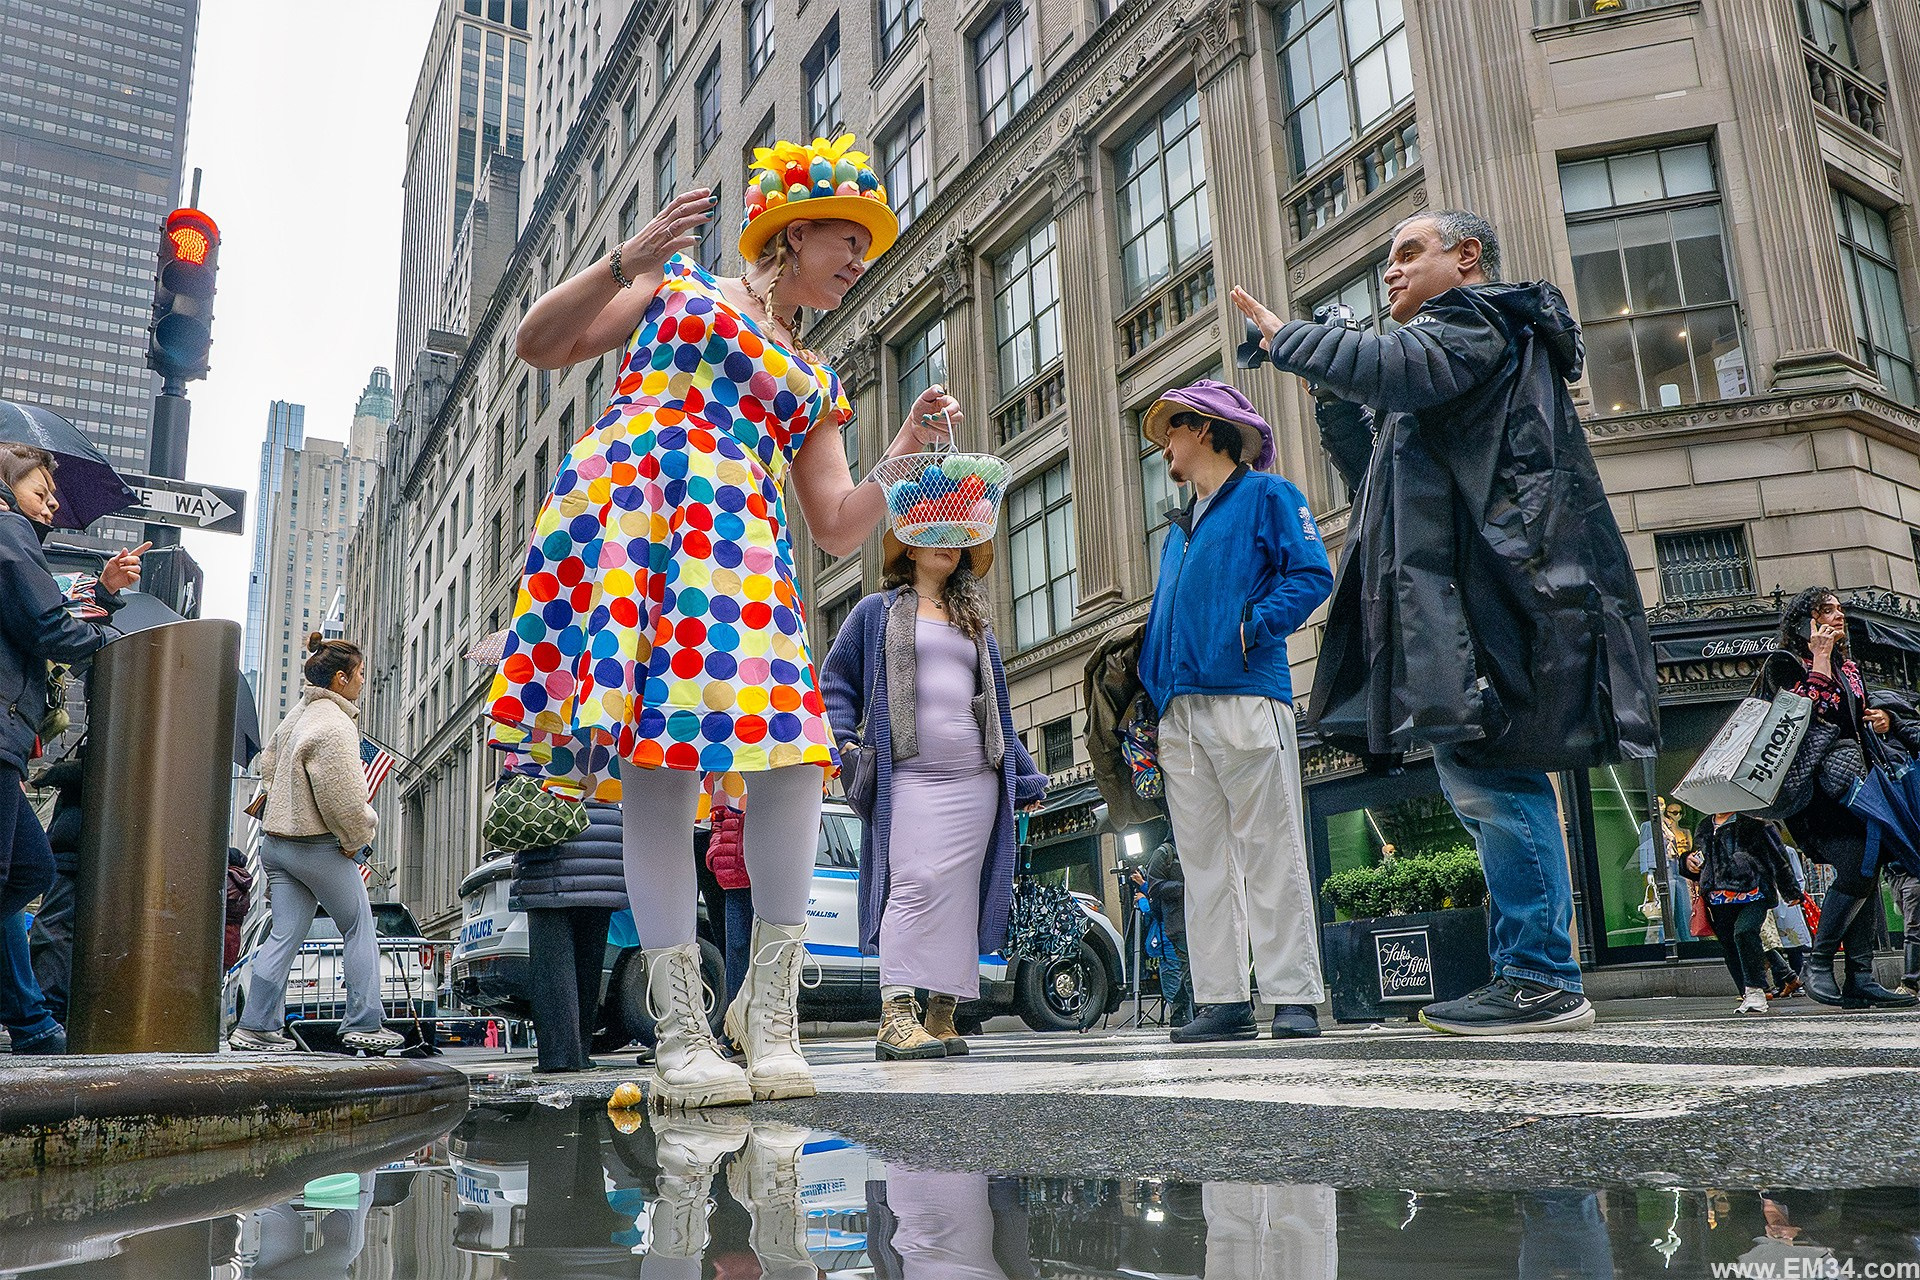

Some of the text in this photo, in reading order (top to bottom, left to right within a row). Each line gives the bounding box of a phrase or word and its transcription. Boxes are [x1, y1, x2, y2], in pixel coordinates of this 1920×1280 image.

[175, 495, 221, 517] WAY
[1702, 640, 1734, 658] Saks
[1730, 638, 1760, 656] Fifth
[469, 919, 493, 941] POLICE
[1380, 942, 1412, 967] Saks
[1397, 955, 1430, 977] Fifth
[1382, 969, 1427, 990] Avenue
